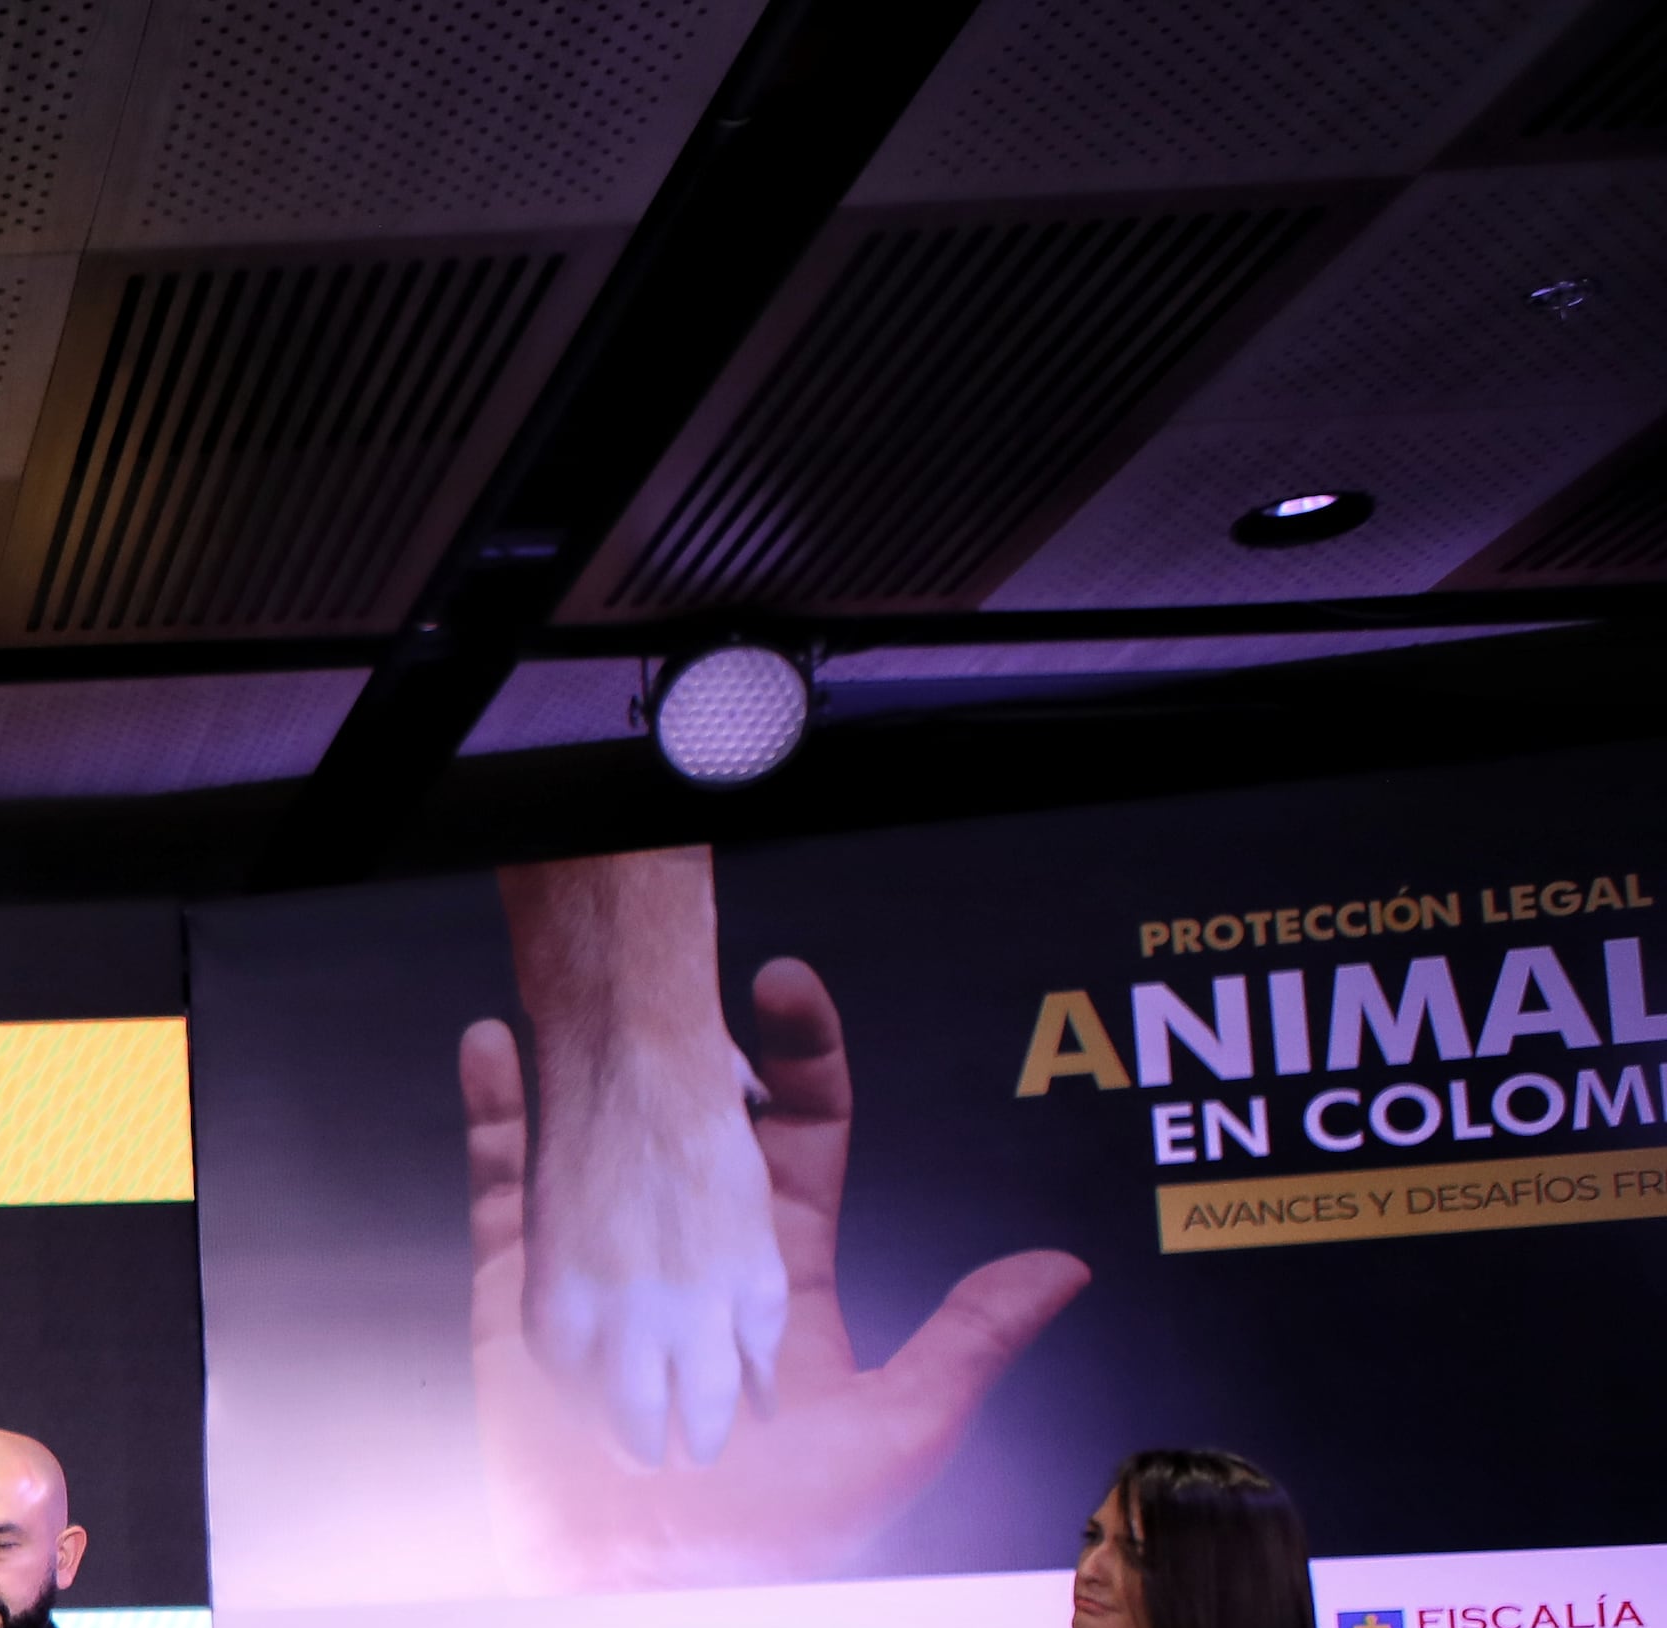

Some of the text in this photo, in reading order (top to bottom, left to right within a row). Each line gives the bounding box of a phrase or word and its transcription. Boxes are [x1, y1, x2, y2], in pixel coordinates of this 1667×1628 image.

[1140, 873, 1654, 958] PROTECCIÓN LEGAL
[1152, 1065, 1667, 1165] EN COLOM
[1183, 1196, 1359, 1233] AVANCES
[1370, 1191, 1393, 1218] Y
[1406, 1172, 1601, 1216] DESAFÍOS
